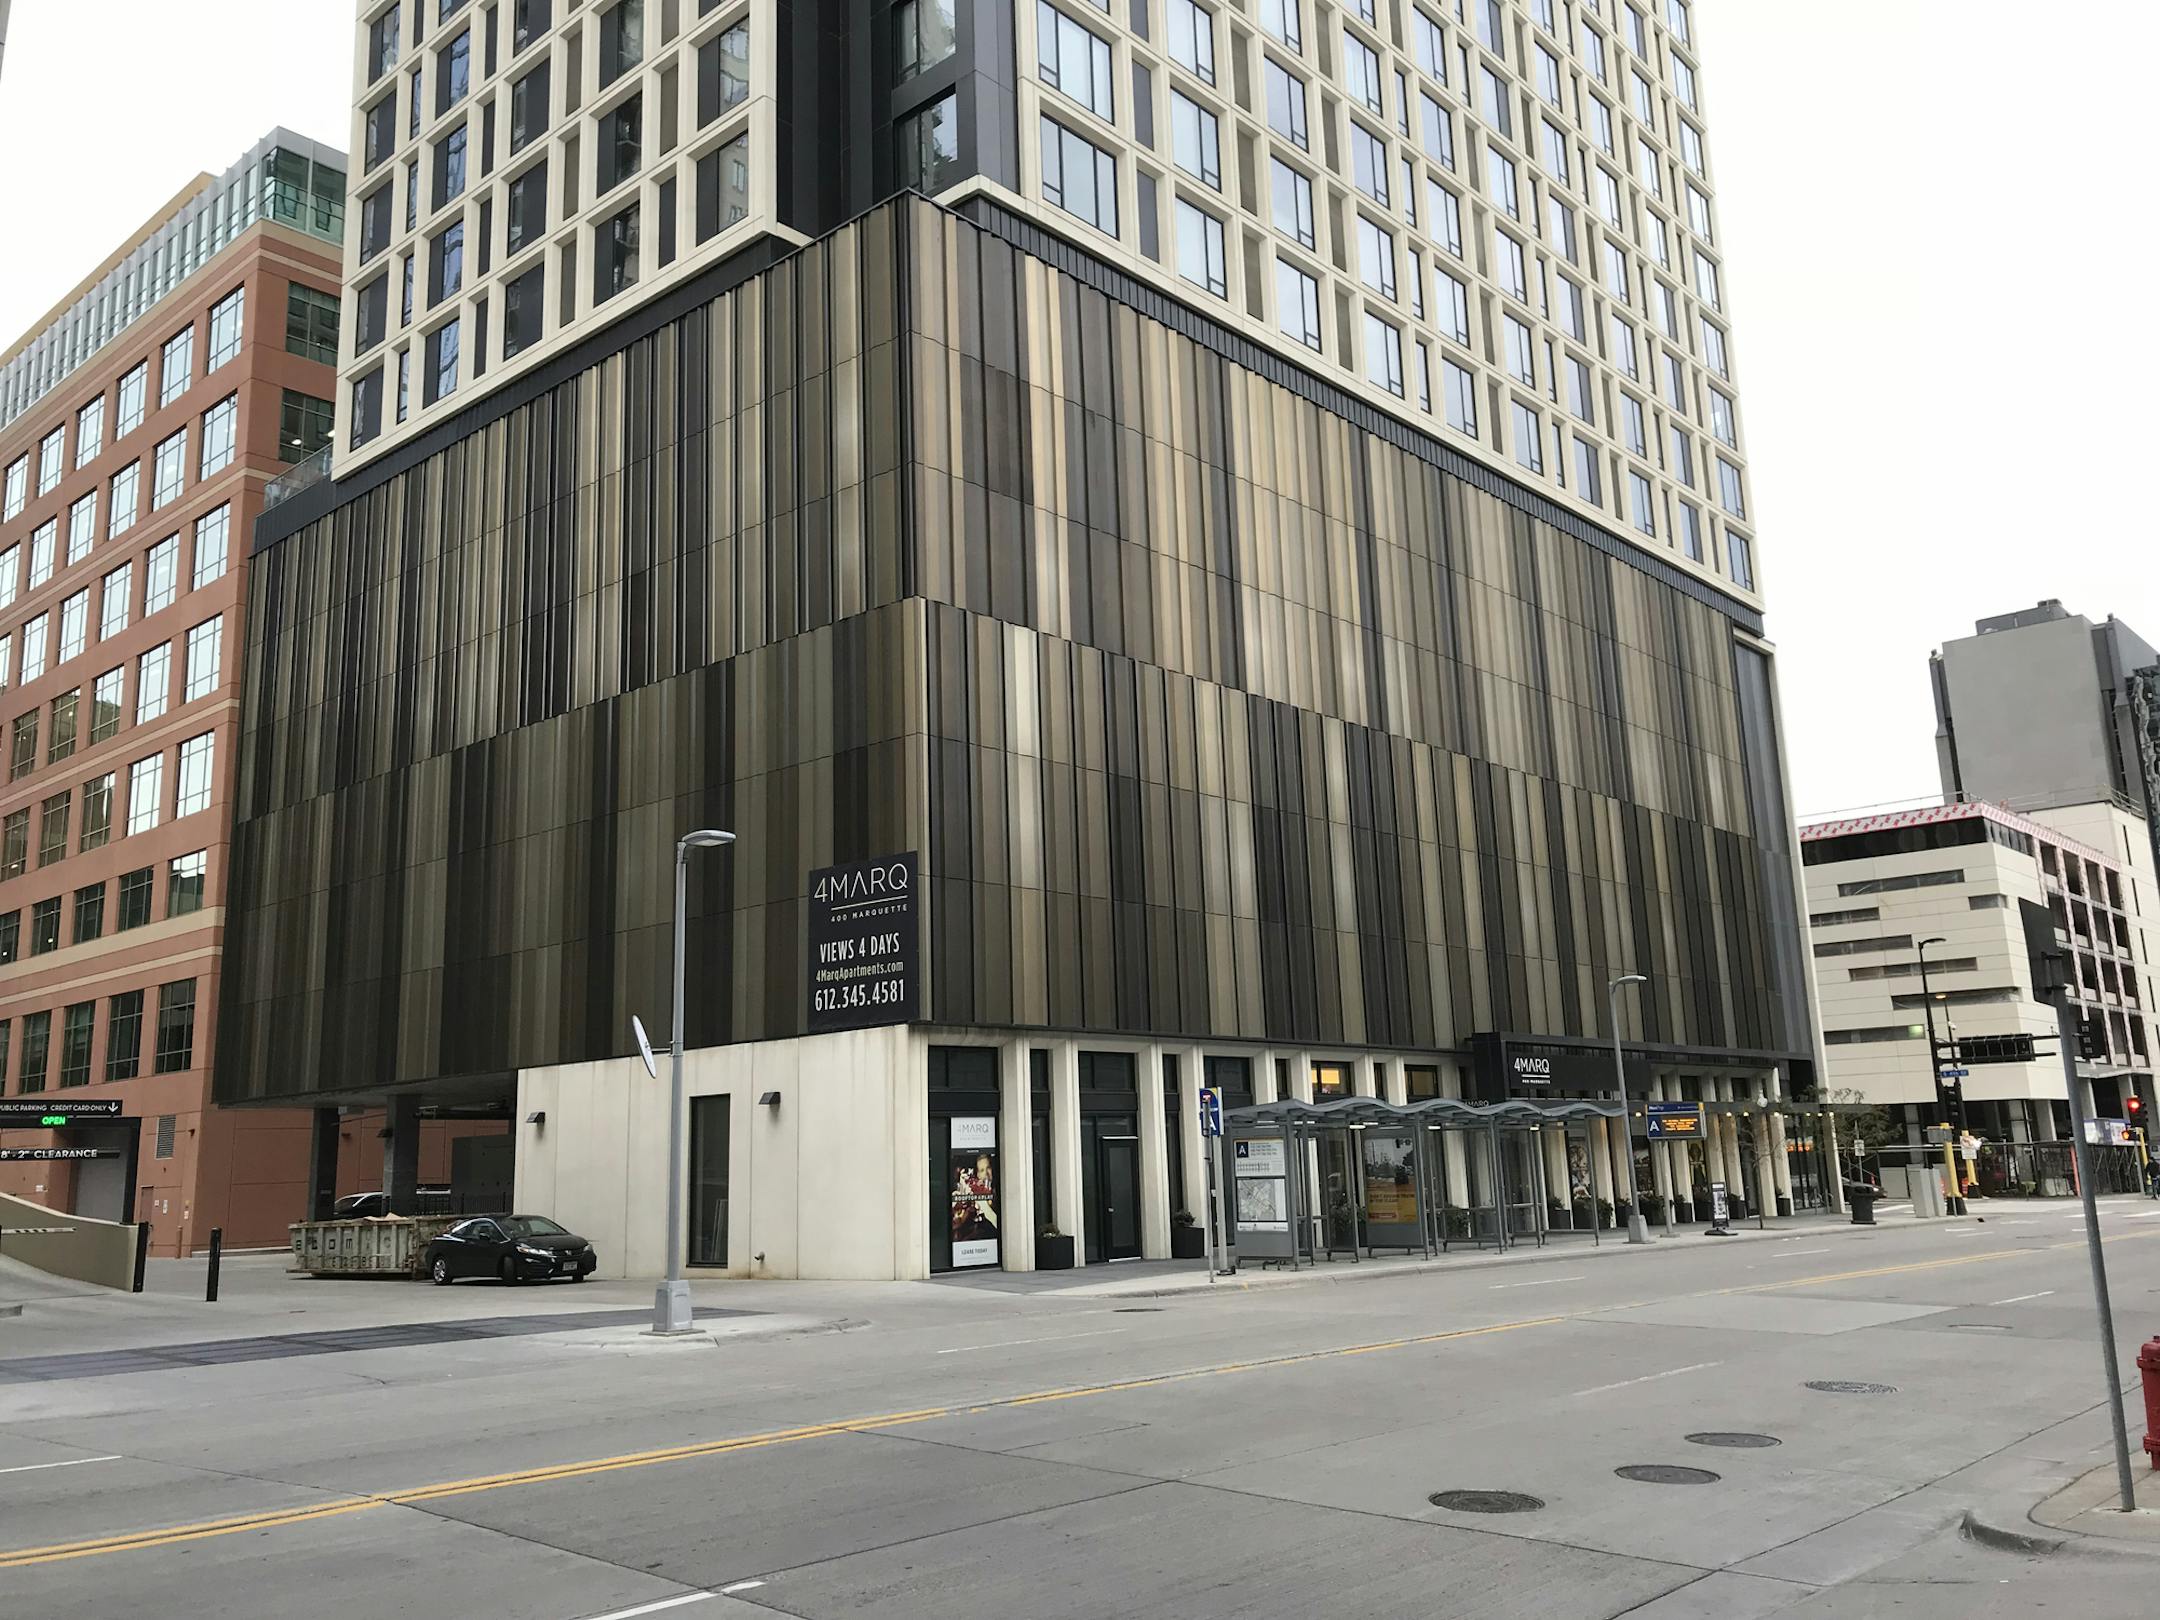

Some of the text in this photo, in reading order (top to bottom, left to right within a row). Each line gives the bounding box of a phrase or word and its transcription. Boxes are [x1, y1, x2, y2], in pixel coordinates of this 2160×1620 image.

[814, 863, 908, 903] 4MARQ
[831, 904, 908, 922] 400 MARQUETTE
[820, 932, 900, 963] VIEWS 4 DAYS
[816, 961, 904, 982] 4MarqApartments.com
[815, 979, 904, 1011] 612.345.4581
[1514, 1057, 1550, 1073] 4MARQ
[42, 1116, 66, 1126] OPEN
[1650, 1120, 1660, 1131] A
[34, 1149, 98, 1159] CLEARANCE
[1239, 1145, 1246, 1155] A
